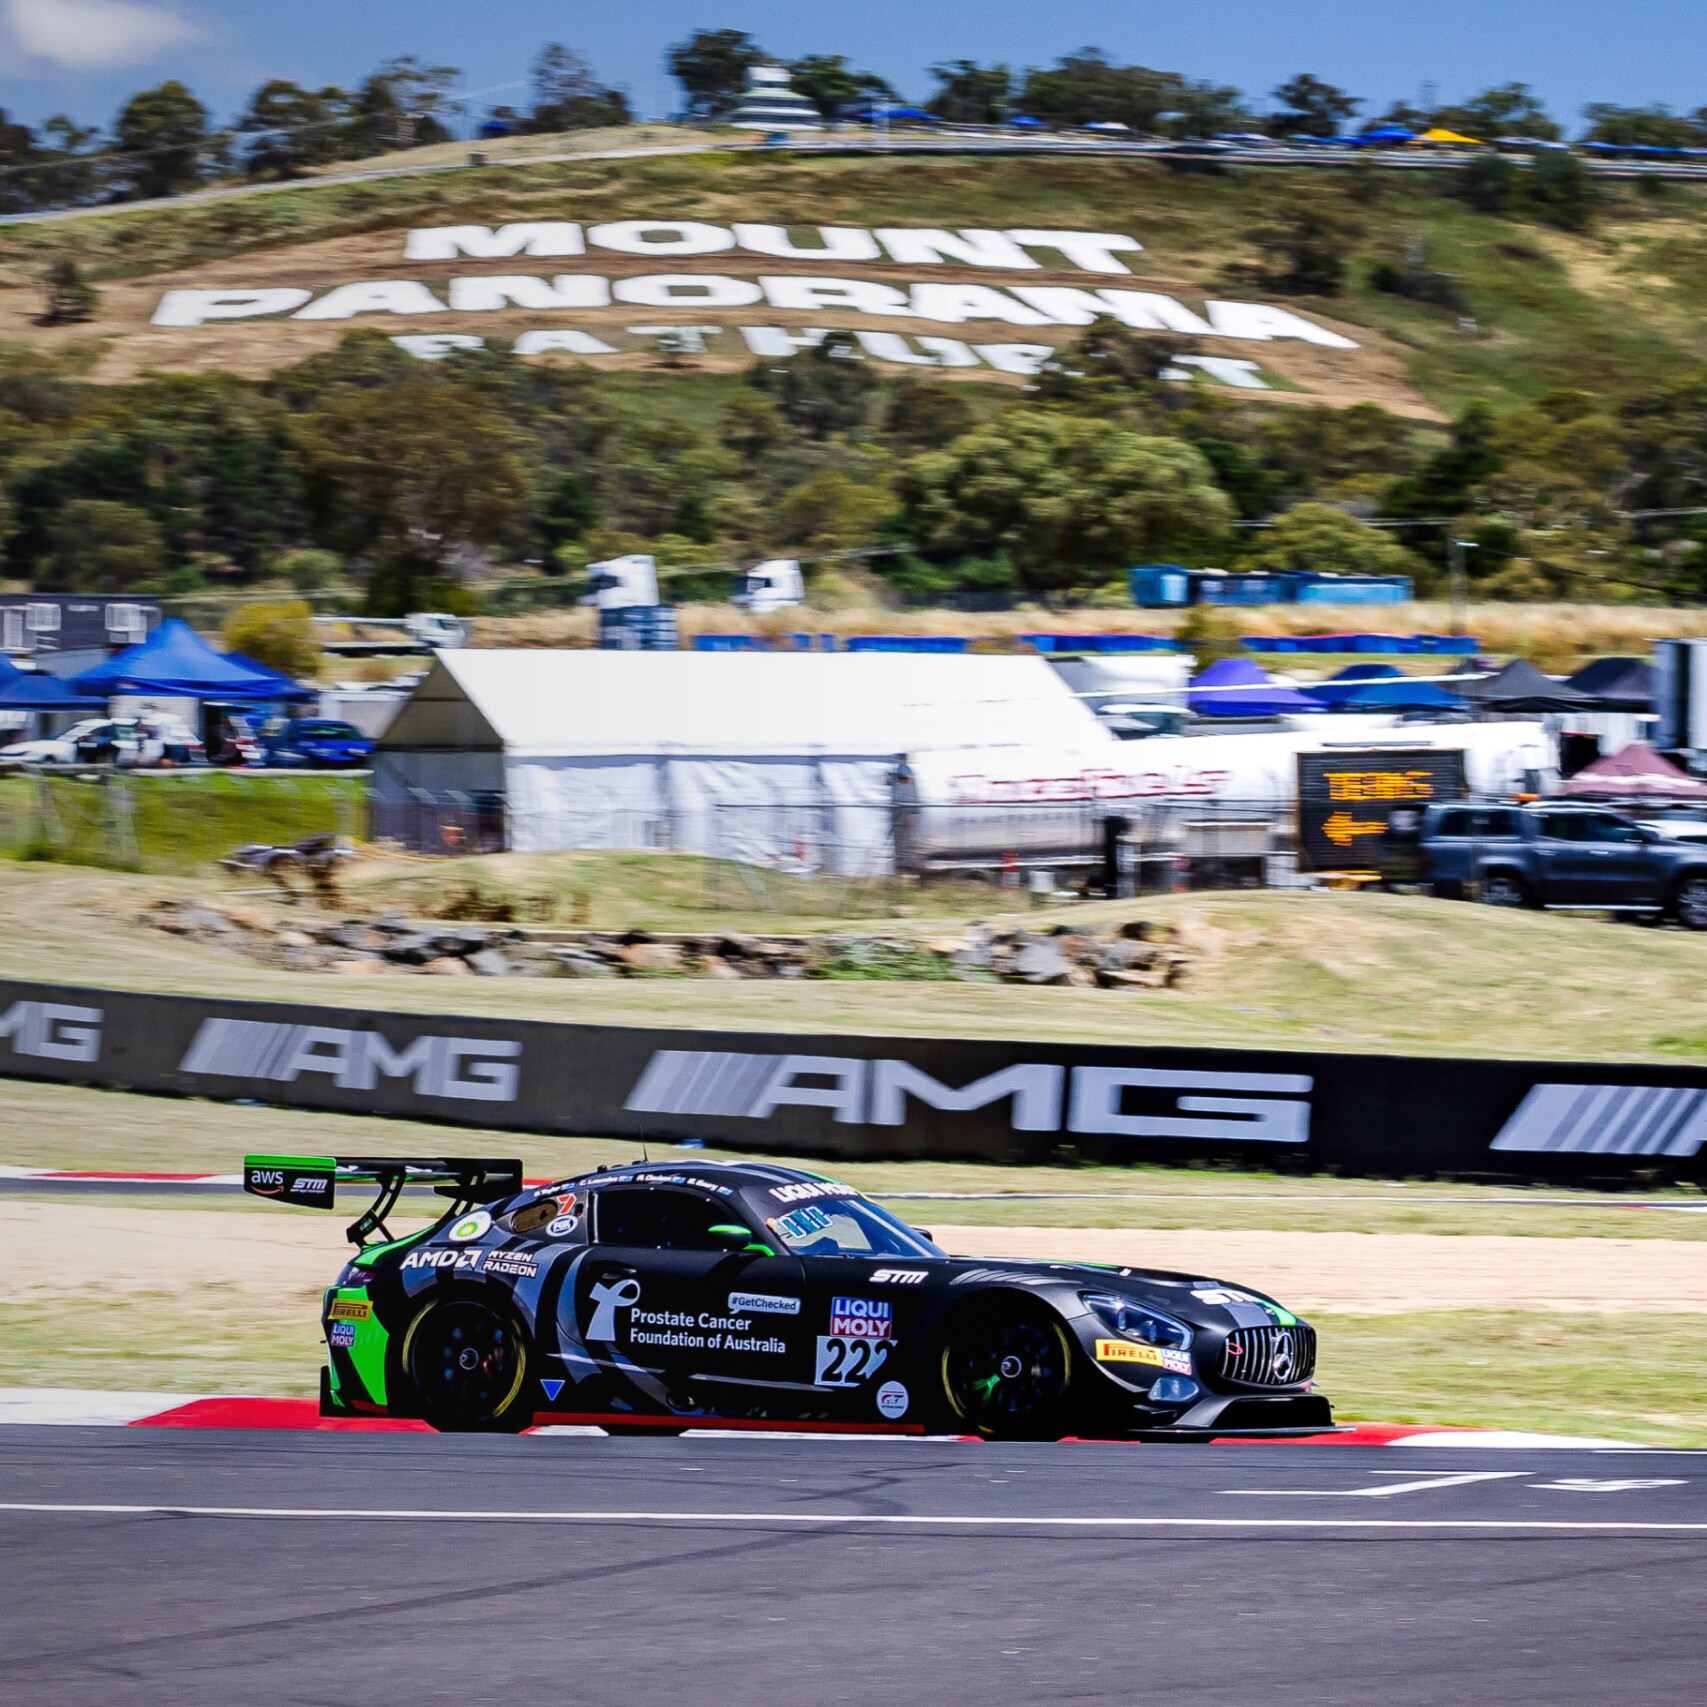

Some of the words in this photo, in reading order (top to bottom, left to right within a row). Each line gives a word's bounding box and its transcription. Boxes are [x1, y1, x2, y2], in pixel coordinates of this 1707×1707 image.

[403, 220, 1143, 274] MOUNT
[150, 273, 1360, 348] PANORAMA
[389, 325, 1273, 390] BATHURT
[272, 1025, 523, 1101] AMG
[748, 1053, 1313, 1143] AMG
[251, 1169, 284, 1185] aws
[292, 1177, 329, 1190] STM
[400, 1249, 459, 1271] AMD
[487, 1250, 533, 1263] RYZEN
[482, 1261, 538, 1278] RADEON
[868, 1268, 930, 1285] STM
[333, 1302, 369, 1318] PIRELLI
[731, 1296, 797, 1311] #GetChecked
[834, 1299, 890, 1318] LIQUI
[630, 1307, 695, 1327] Prostate
[698, 1312, 752, 1331] Cancer
[833, 1317, 890, 1336] MOLY
[333, 1323, 355, 1336] LIQUI
[331, 1334, 354, 1347] MOLY
[630, 1327, 705, 1348] Foundation
[707, 1333, 722, 1349] of
[724, 1333, 786, 1353] Australia
[821, 1337, 893, 1384] 222
[1103, 1343, 1158, 1361] PIRELLI
